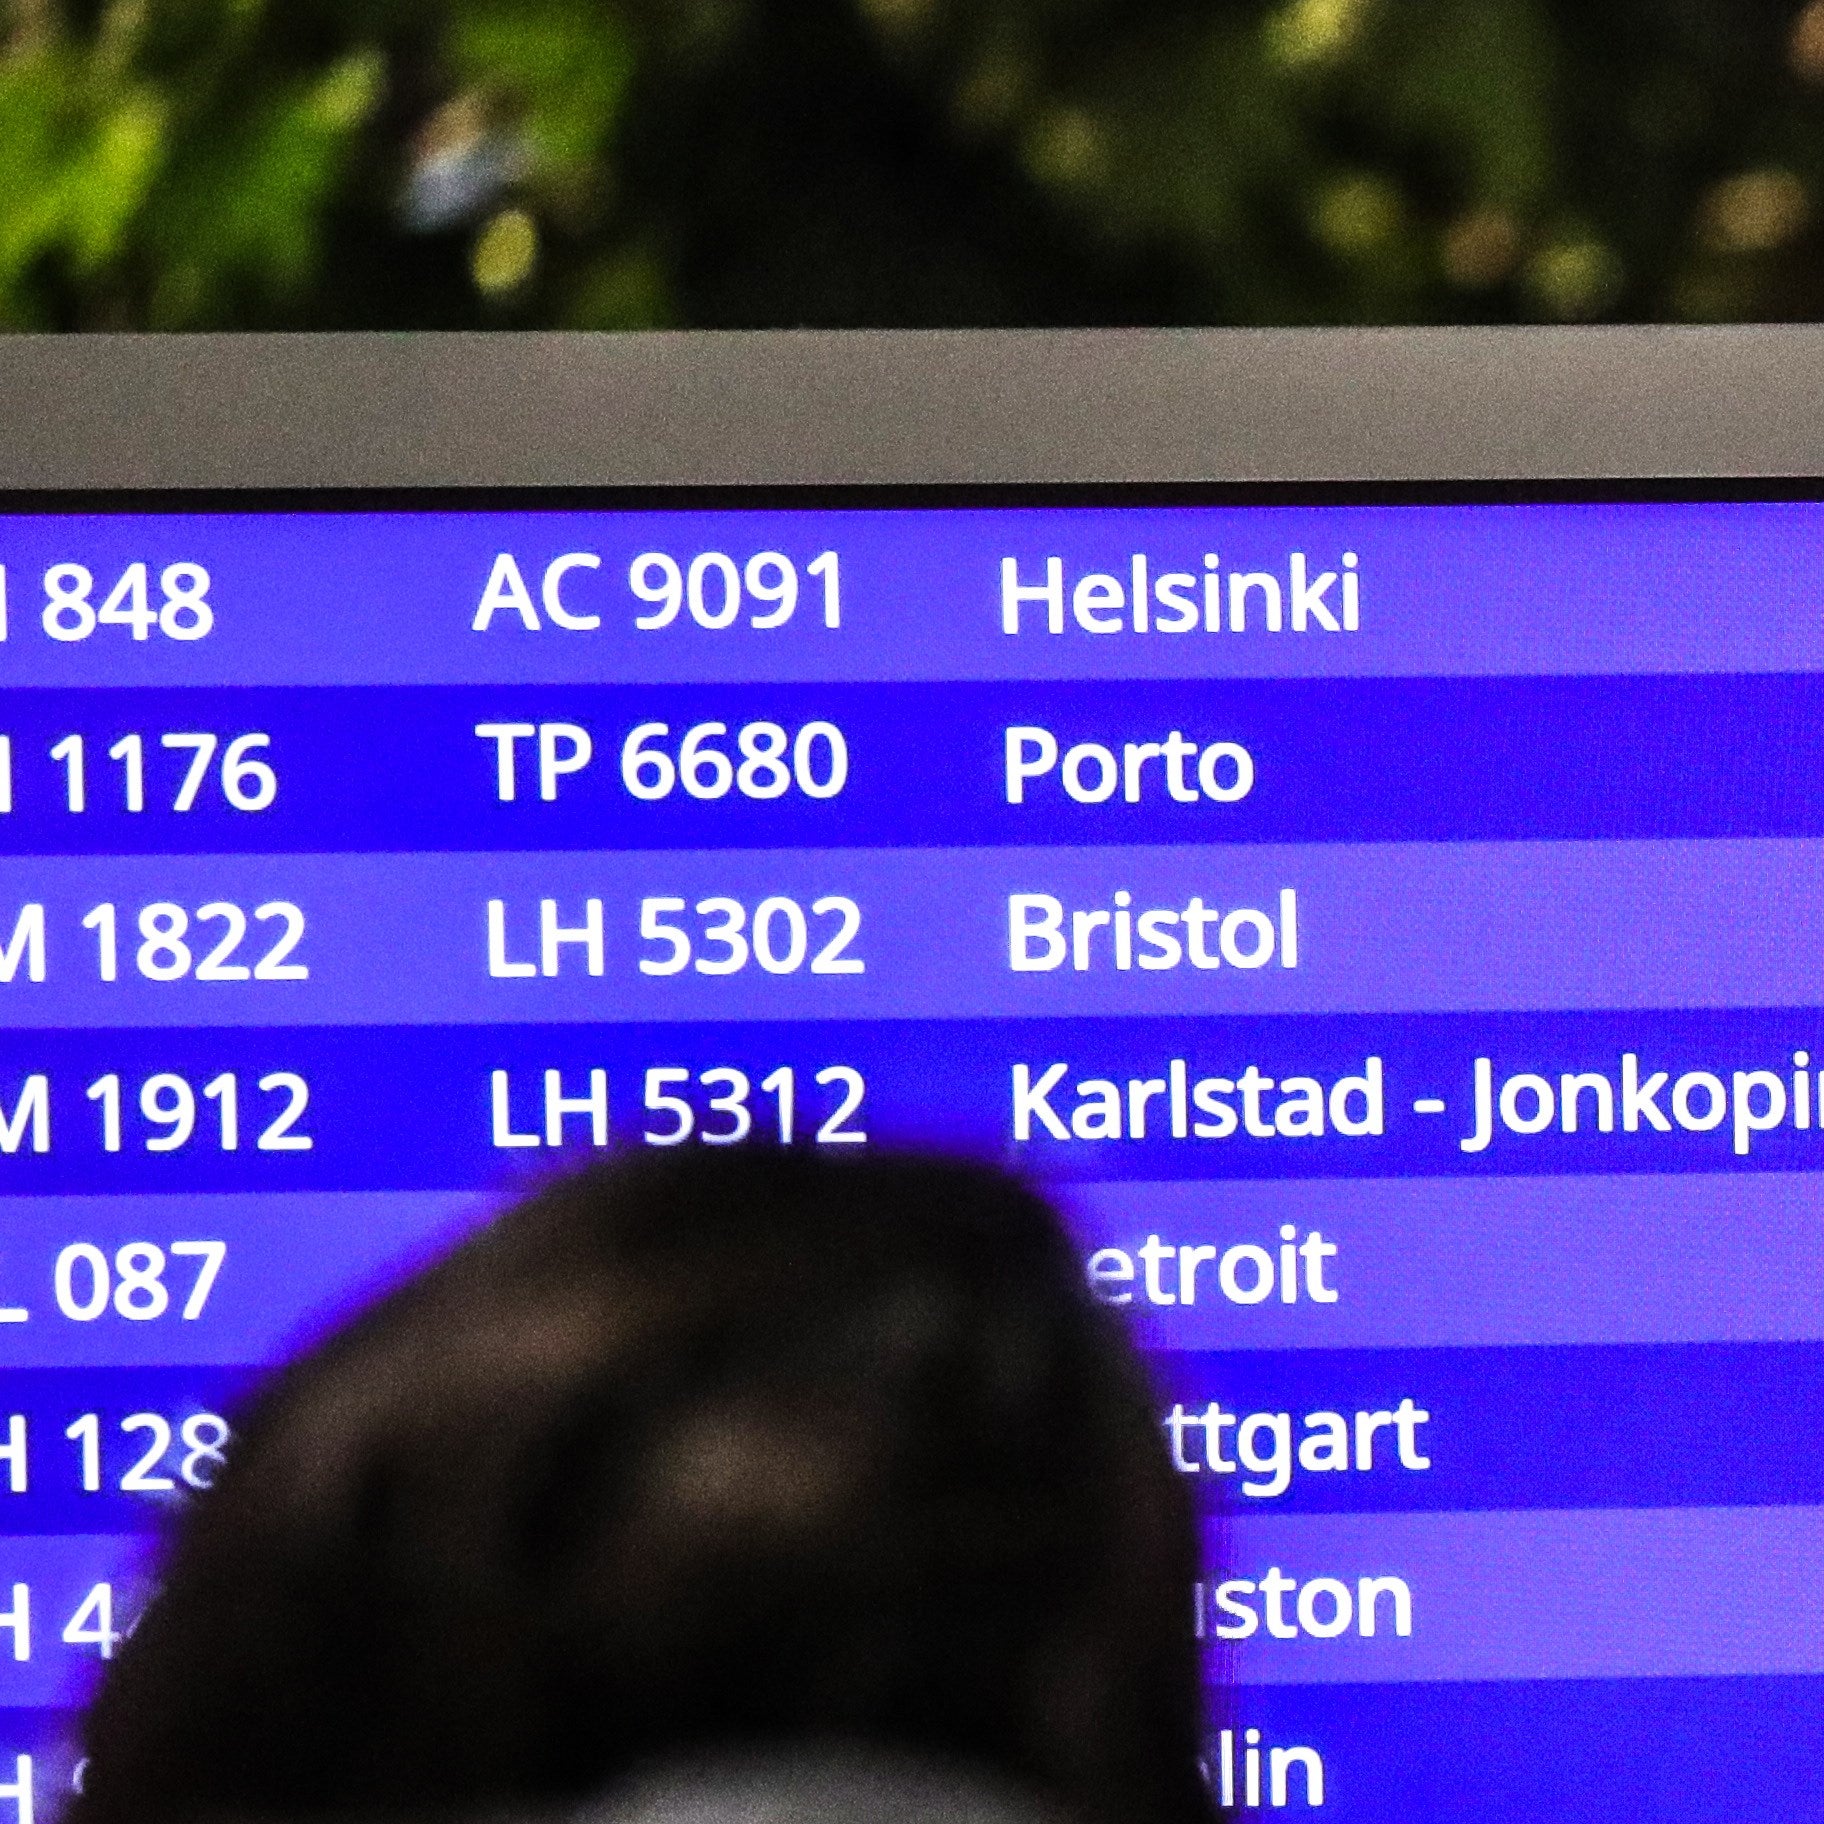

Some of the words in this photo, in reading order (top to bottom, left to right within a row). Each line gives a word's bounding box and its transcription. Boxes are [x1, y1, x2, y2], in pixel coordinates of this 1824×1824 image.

[41, 561, 215, 643] 848
[471, 551, 602, 632] AC
[628, 550, 841, 631] 9091
[1000, 550, 1360, 636] Helsinki
[50, 732, 277, 813] 1176
[473, 722, 592, 802] TP
[621, 720, 849, 801] 6680
[1005, 725, 1255, 805] Porto
[81, 899, 310, 983] 1822
[487, 897, 605, 979] LH
[638, 895, 866, 977] 5302
[1007, 887, 1299, 973] Bristol
[86, 1071, 313, 1153] 1912
[491, 1068, 608, 1148] LH
[643, 1065, 868, 1146] 5312
[1012, 1055, 1384, 1141] Karlstad
[53, 1239, 227, 1323] 087
[1086, 1223, 1340, 1306] etroit
[65, 1412, 231, 1493] 128
[1163, 1397, 1432, 1498] ttgart
[1194, 1565, 1413, 1640] ston
